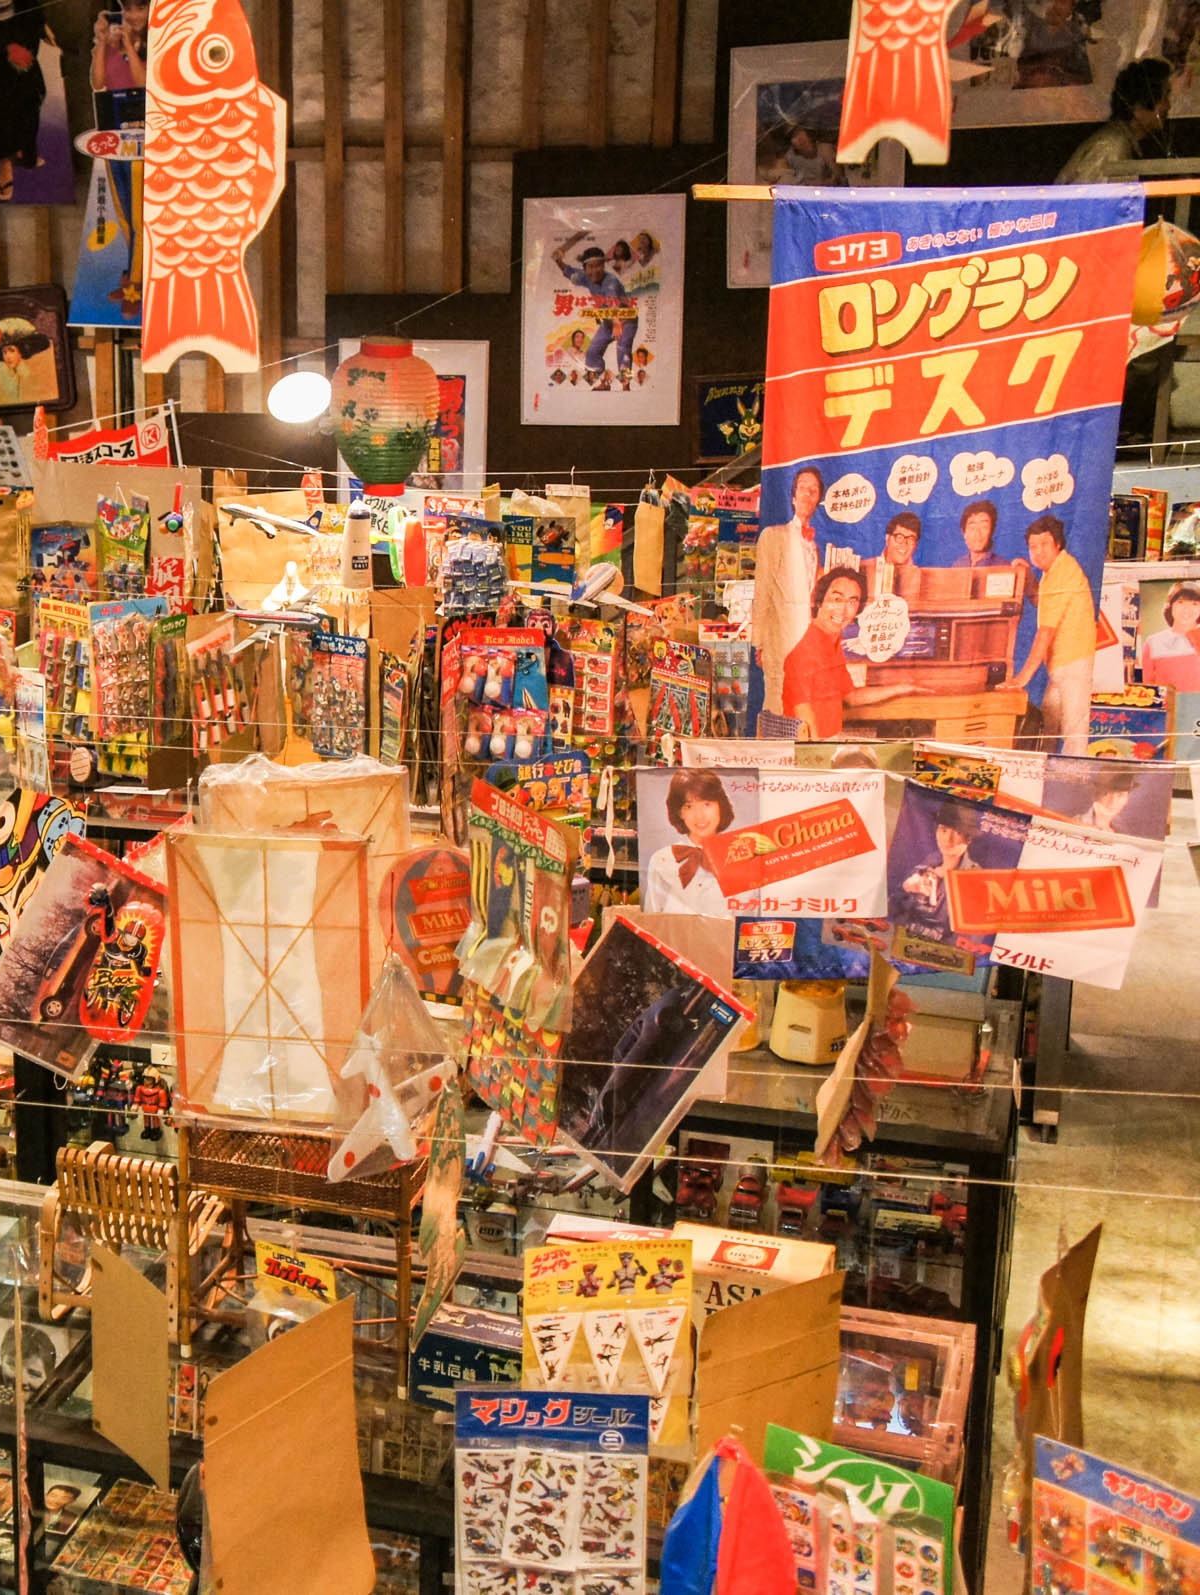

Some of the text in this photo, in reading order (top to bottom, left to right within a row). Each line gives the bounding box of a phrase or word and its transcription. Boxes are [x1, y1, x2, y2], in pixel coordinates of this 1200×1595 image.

[828, 238, 888, 265] コクヨ
[819, 254, 1081, 355] ロングラン
[823, 330, 1083, 449] デスク
[508, 634, 535, 645] Model
[774, 811, 857, 849] Ghana
[984, 877, 1096, 914] Mild
[748, 948, 784, 962] デスク
[1102, 1470, 1193, 1522] キン肉マン
